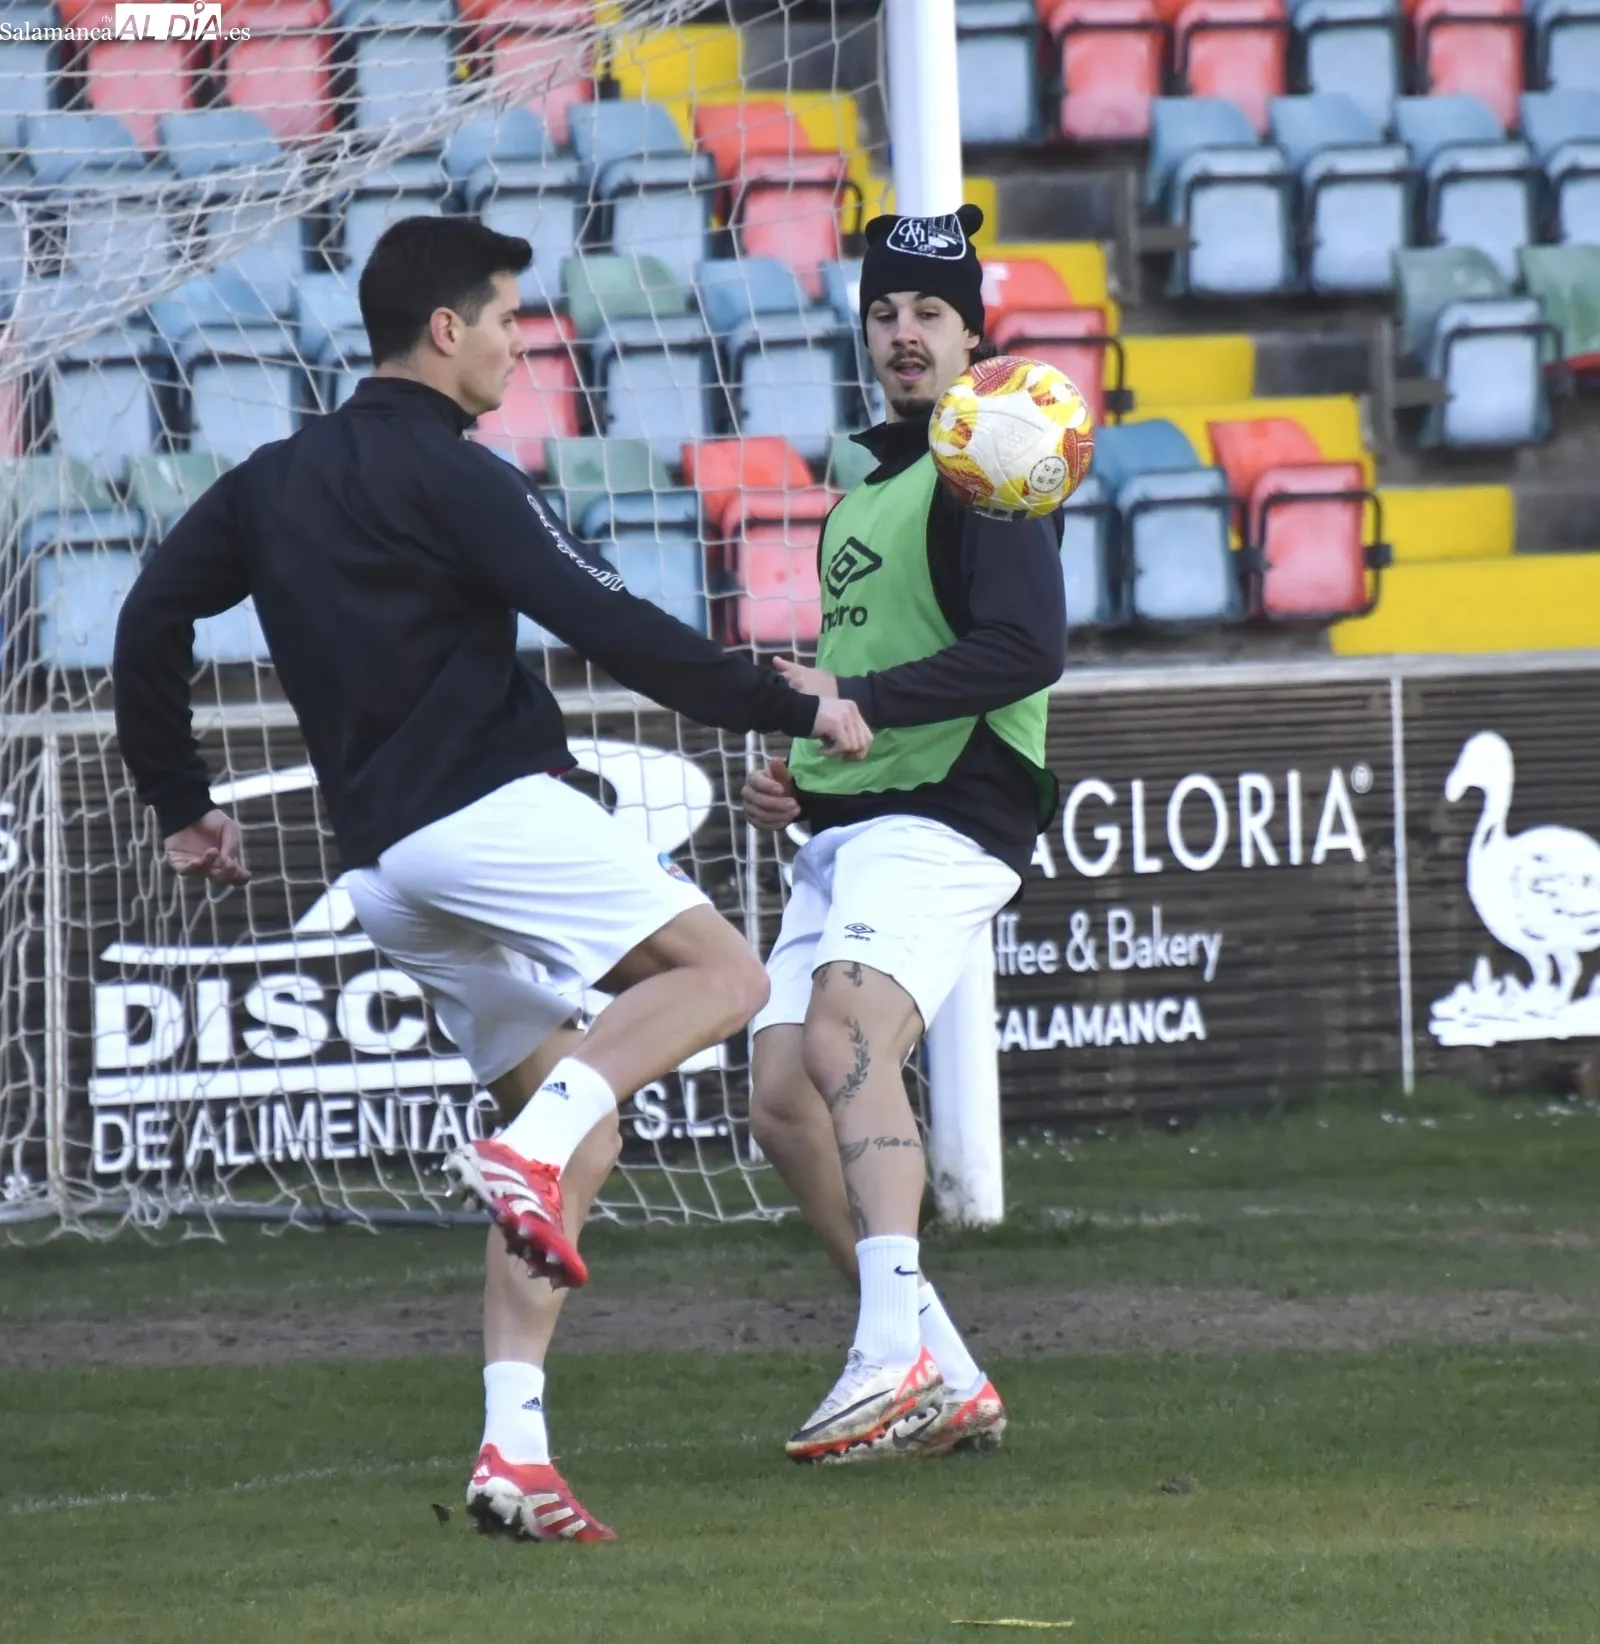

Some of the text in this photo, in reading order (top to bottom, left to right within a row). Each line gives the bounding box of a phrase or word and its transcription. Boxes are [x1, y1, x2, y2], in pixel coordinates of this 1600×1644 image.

[1066, 910, 1100, 973] &
[1107, 904, 1223, 983] Bakery
[95, 1109, 173, 1174] DE
[185, 1090, 501, 1168] ALIMENTAC
